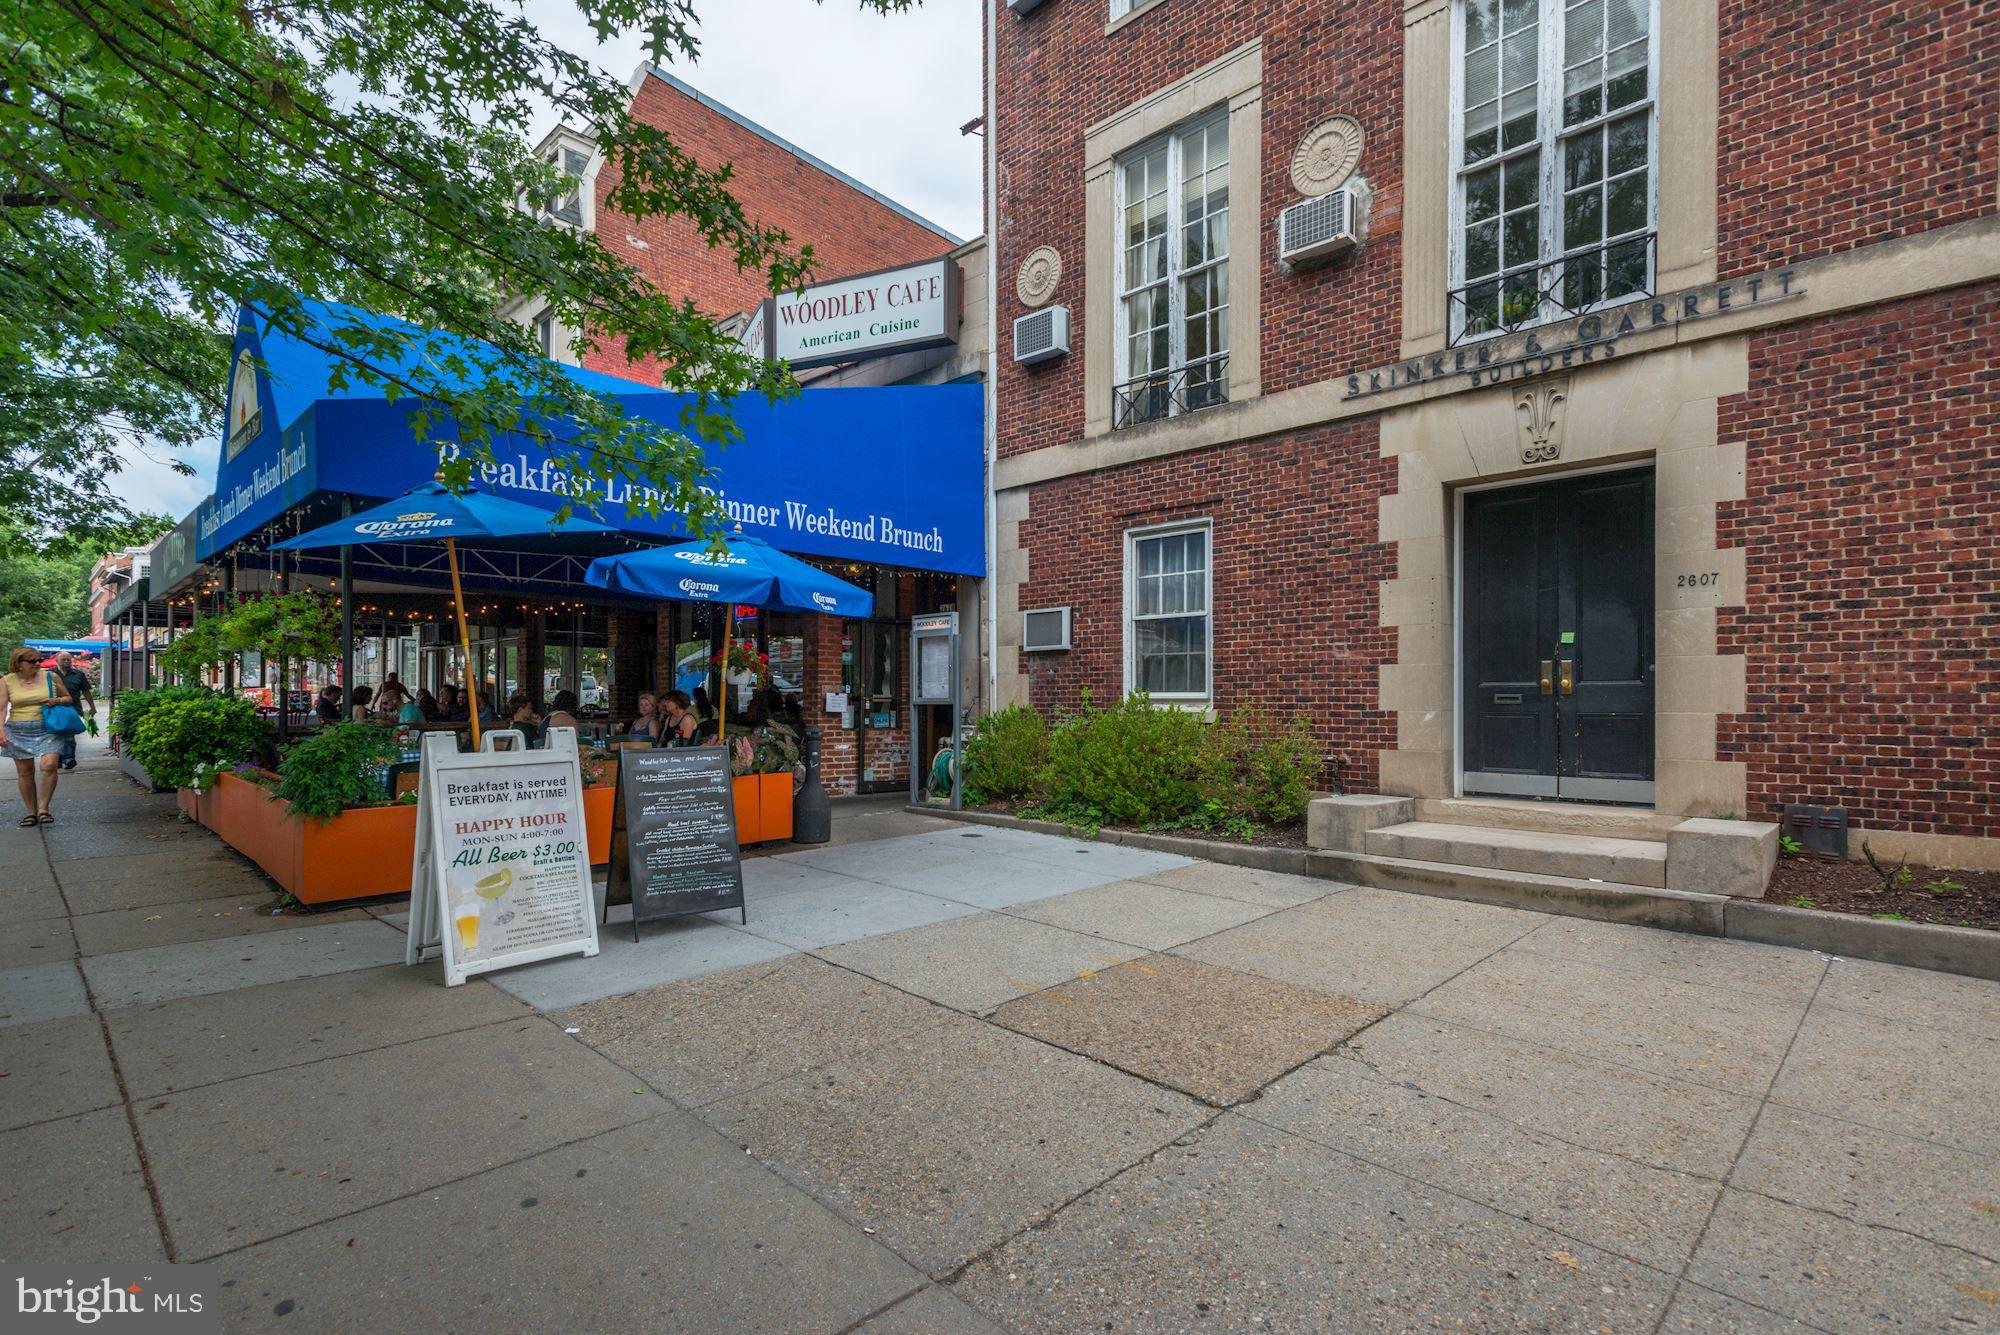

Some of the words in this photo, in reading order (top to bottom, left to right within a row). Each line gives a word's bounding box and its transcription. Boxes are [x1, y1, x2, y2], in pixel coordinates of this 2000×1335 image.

[780, 287, 880, 327] WOODLEY
[887, 275, 942, 309] CAFE
[799, 329, 861, 349] American
[869, 318, 921, 337] Cuisine
[1347, 346, 1489, 397] SKINKER
[1525, 333, 1543, 355] &
[1578, 270, 1796, 340] GARRETT
[1470, 339, 1617, 387] BUILDERS
[252, 452, 281, 501] Weekend
[281, 432, 307, 483] Brunch
[354, 518, 455, 534] Corona
[376, 529, 431, 539] Extra
[784, 500, 876, 542] Weekend
[880, 517, 944, 553] Brunch
[679, 578, 720, 593] Corona
[1677, 572, 1719, 587] 2607
[688, 590, 709, 599] Extra
[812, 591, 838, 606] Corona
[448, 780, 509, 794] Breakfast
[513, 779, 524, 789] is
[528, 776, 567, 788] served
[516, 788, 568, 801] ANYTIME!
[456, 817, 515, 835] HAPPY
[520, 812, 568, 828] HOUR
[462, 832, 518, 847] MON-SUN
[520, 827, 564, 840] 4:00-7:00
[452, 847, 482, 868] All
[487, 846, 528, 863] Beer
[533, 841, 575, 858] $3.00
